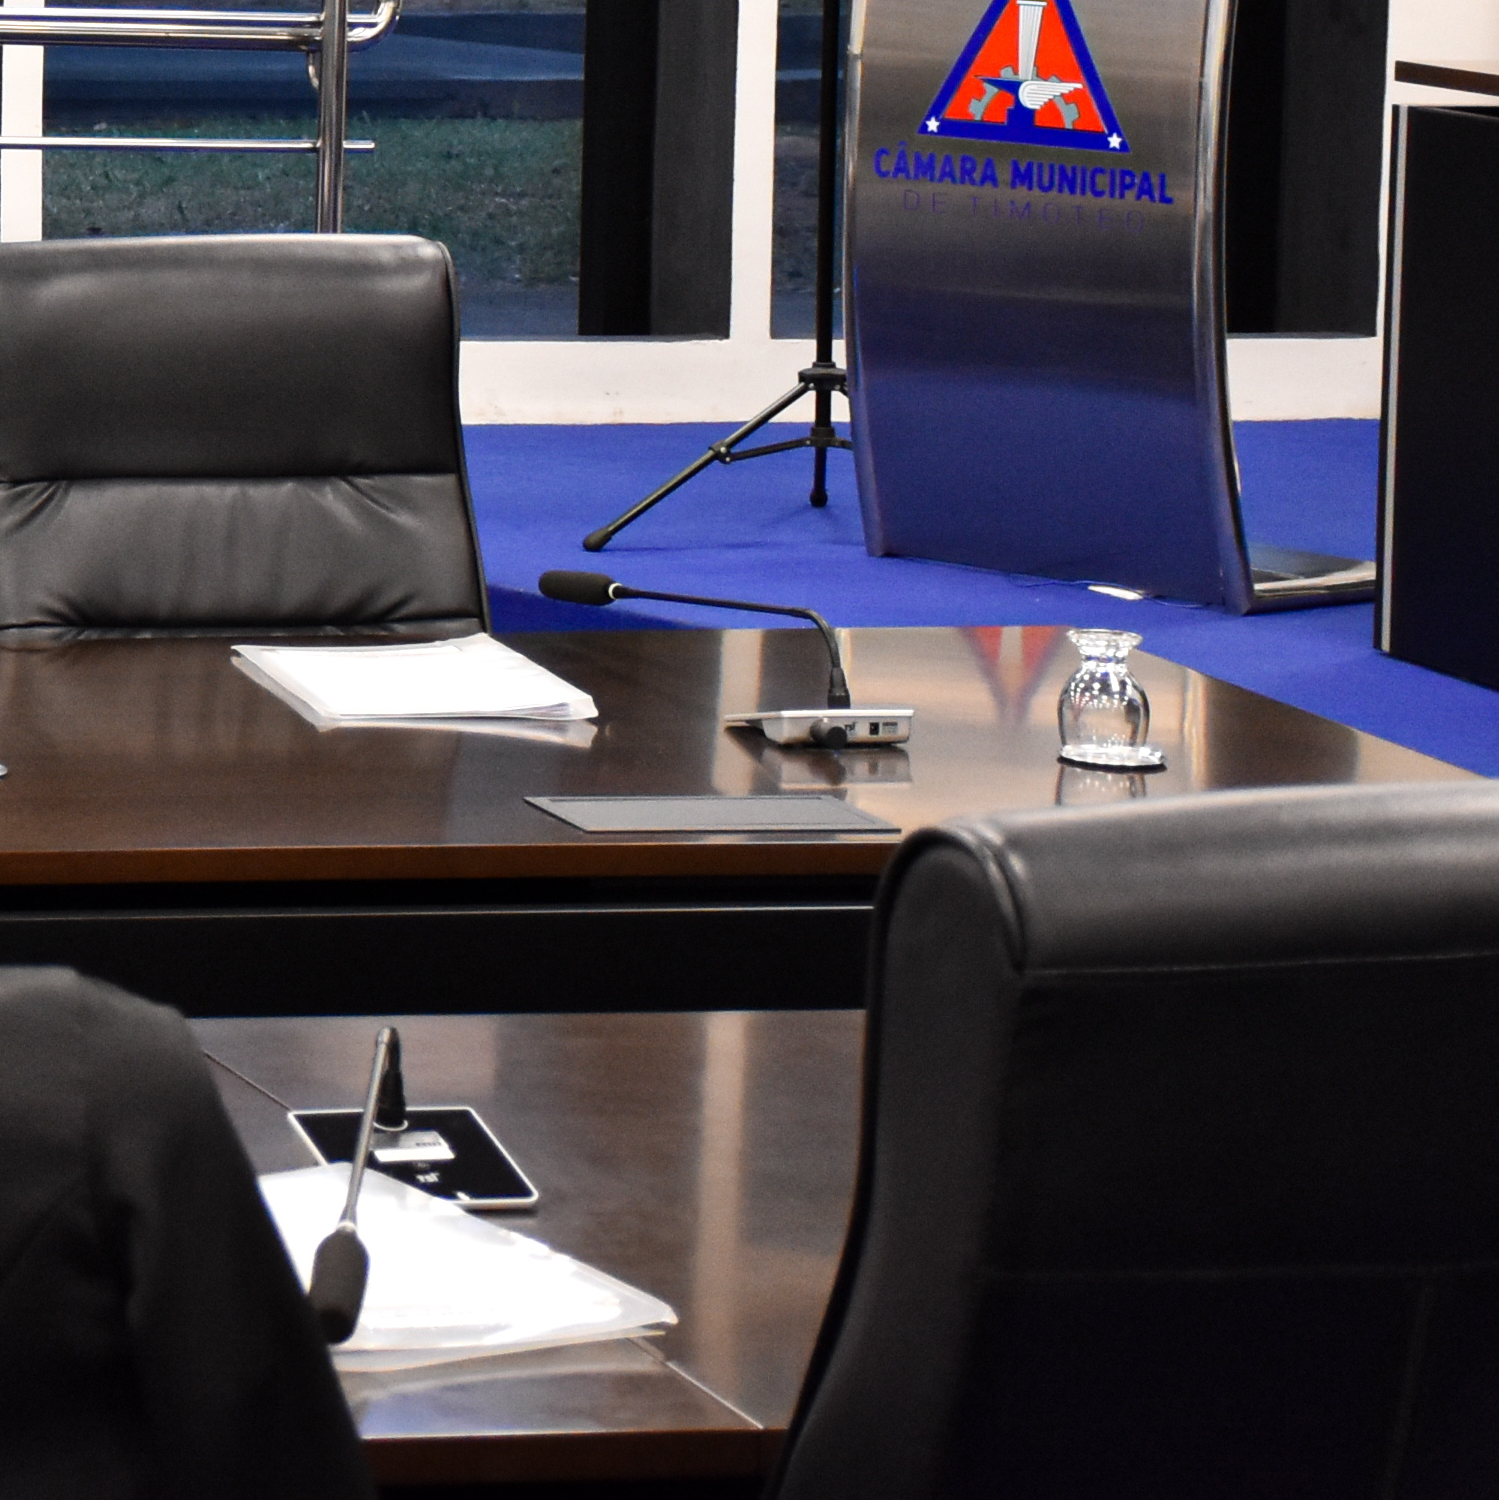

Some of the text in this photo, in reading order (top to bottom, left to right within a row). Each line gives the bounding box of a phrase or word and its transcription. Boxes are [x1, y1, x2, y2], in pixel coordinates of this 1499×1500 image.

[873, 140, 1174, 205] CÂMARA MUNICIPAL
[902, 189, 948, 214] DE
